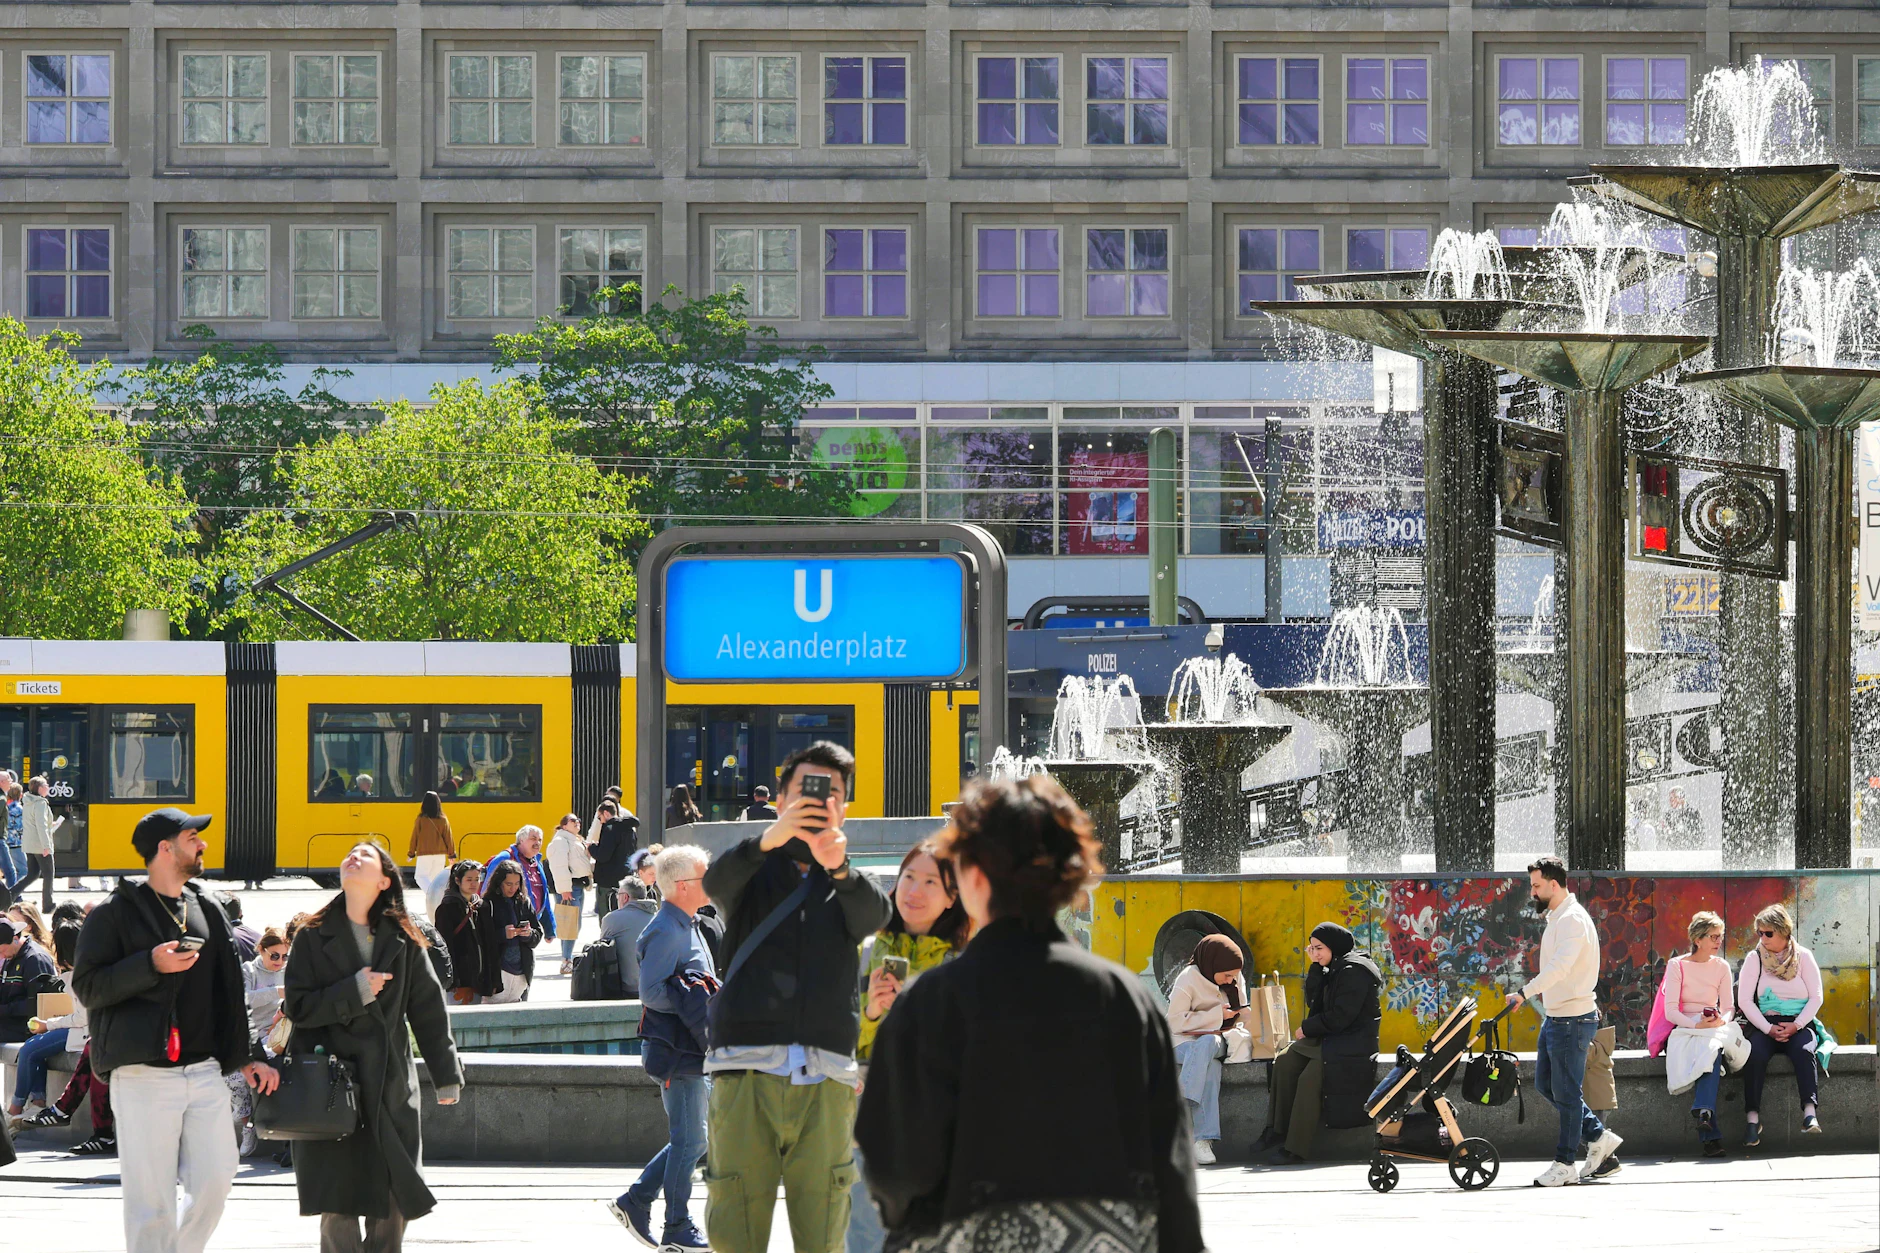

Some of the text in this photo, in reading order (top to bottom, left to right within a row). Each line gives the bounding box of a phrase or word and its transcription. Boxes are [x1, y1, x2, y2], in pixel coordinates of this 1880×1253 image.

[794, 569, 833, 623] U
[716, 632, 908, 666] Alexanderplatz
[1088, 653, 1117, 673] POLIZEI
[20, 683, 59, 694] Tickets
